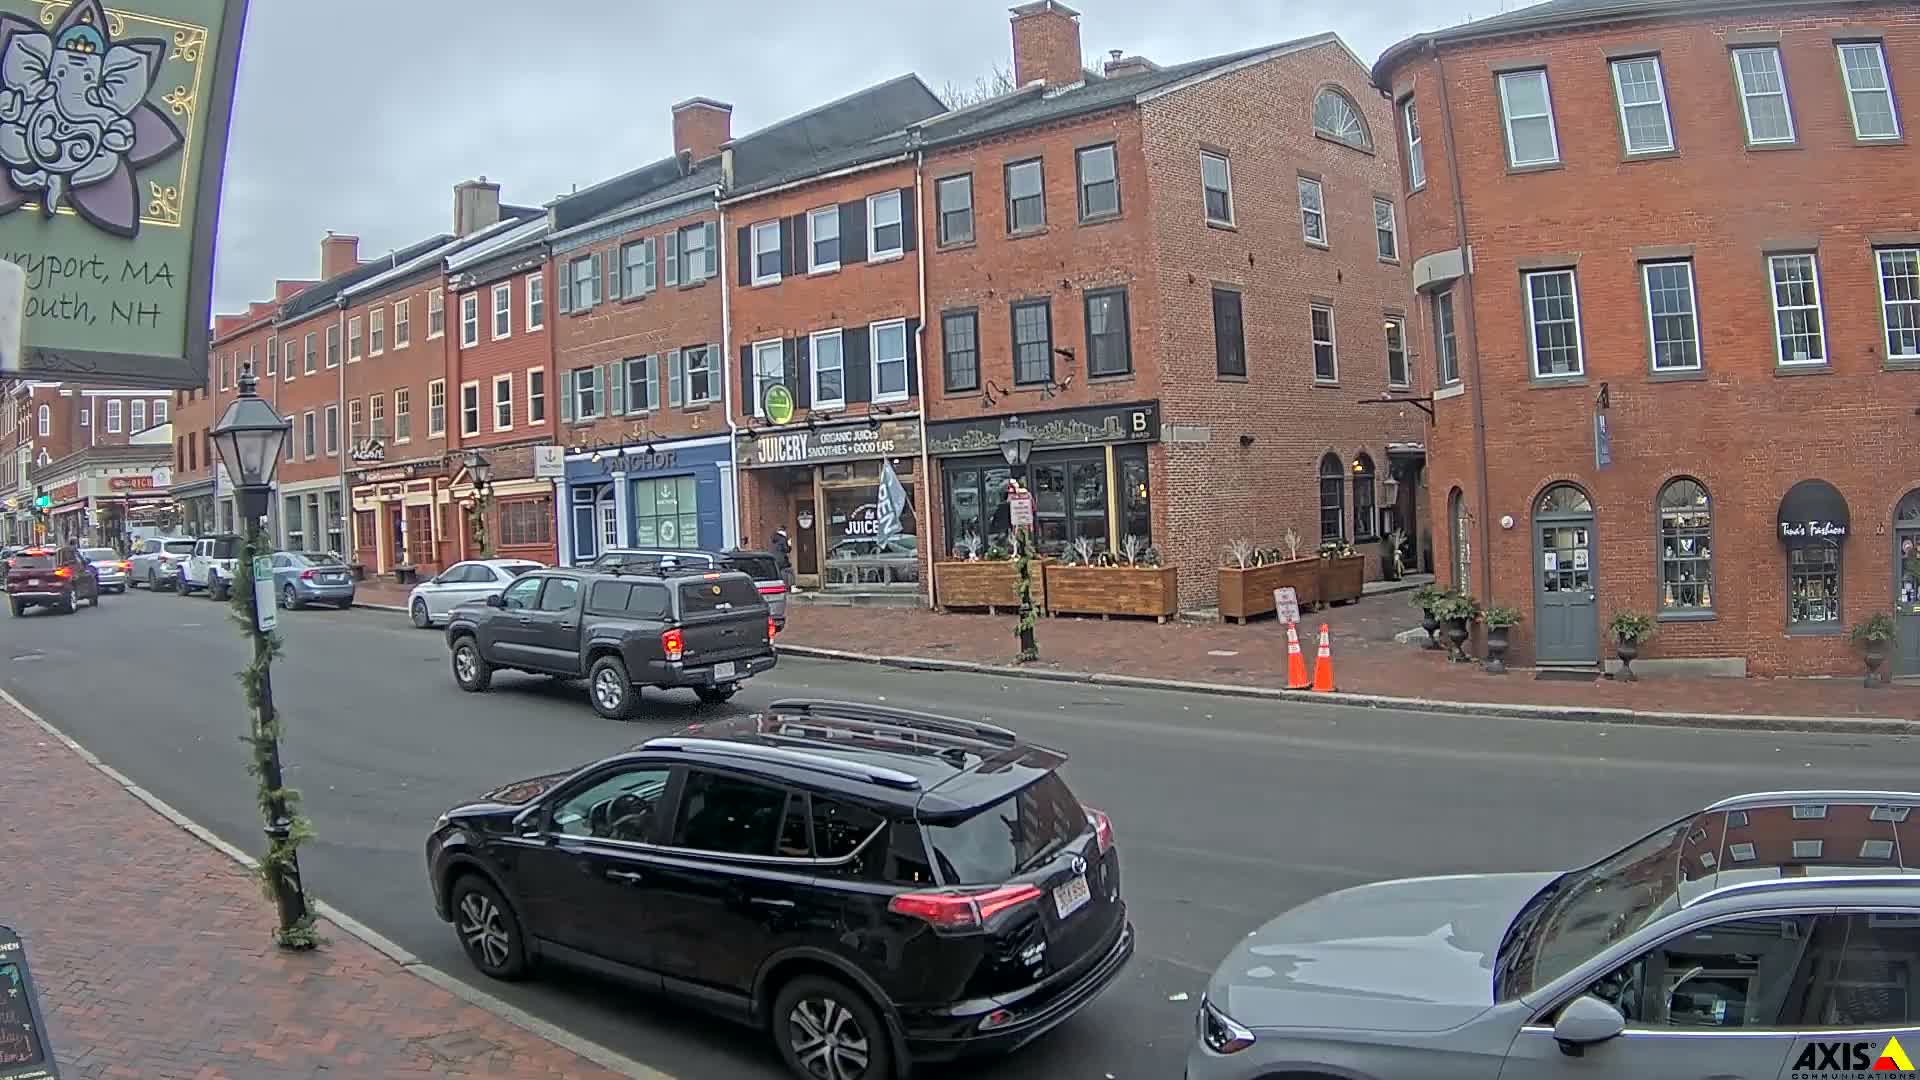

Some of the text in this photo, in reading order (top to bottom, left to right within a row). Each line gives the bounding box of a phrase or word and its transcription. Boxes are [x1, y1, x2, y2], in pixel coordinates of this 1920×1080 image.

[121, 259, 175, 289] MA
[111, 301, 161, 329] NH
[757, 434, 808, 463] JUICERY
[808, 440, 895, 458] SMOOTHIES GOOD EATS
[820, 432, 852, 444] ORGANIC
[1809, 521, 1846, 537] Fashion
